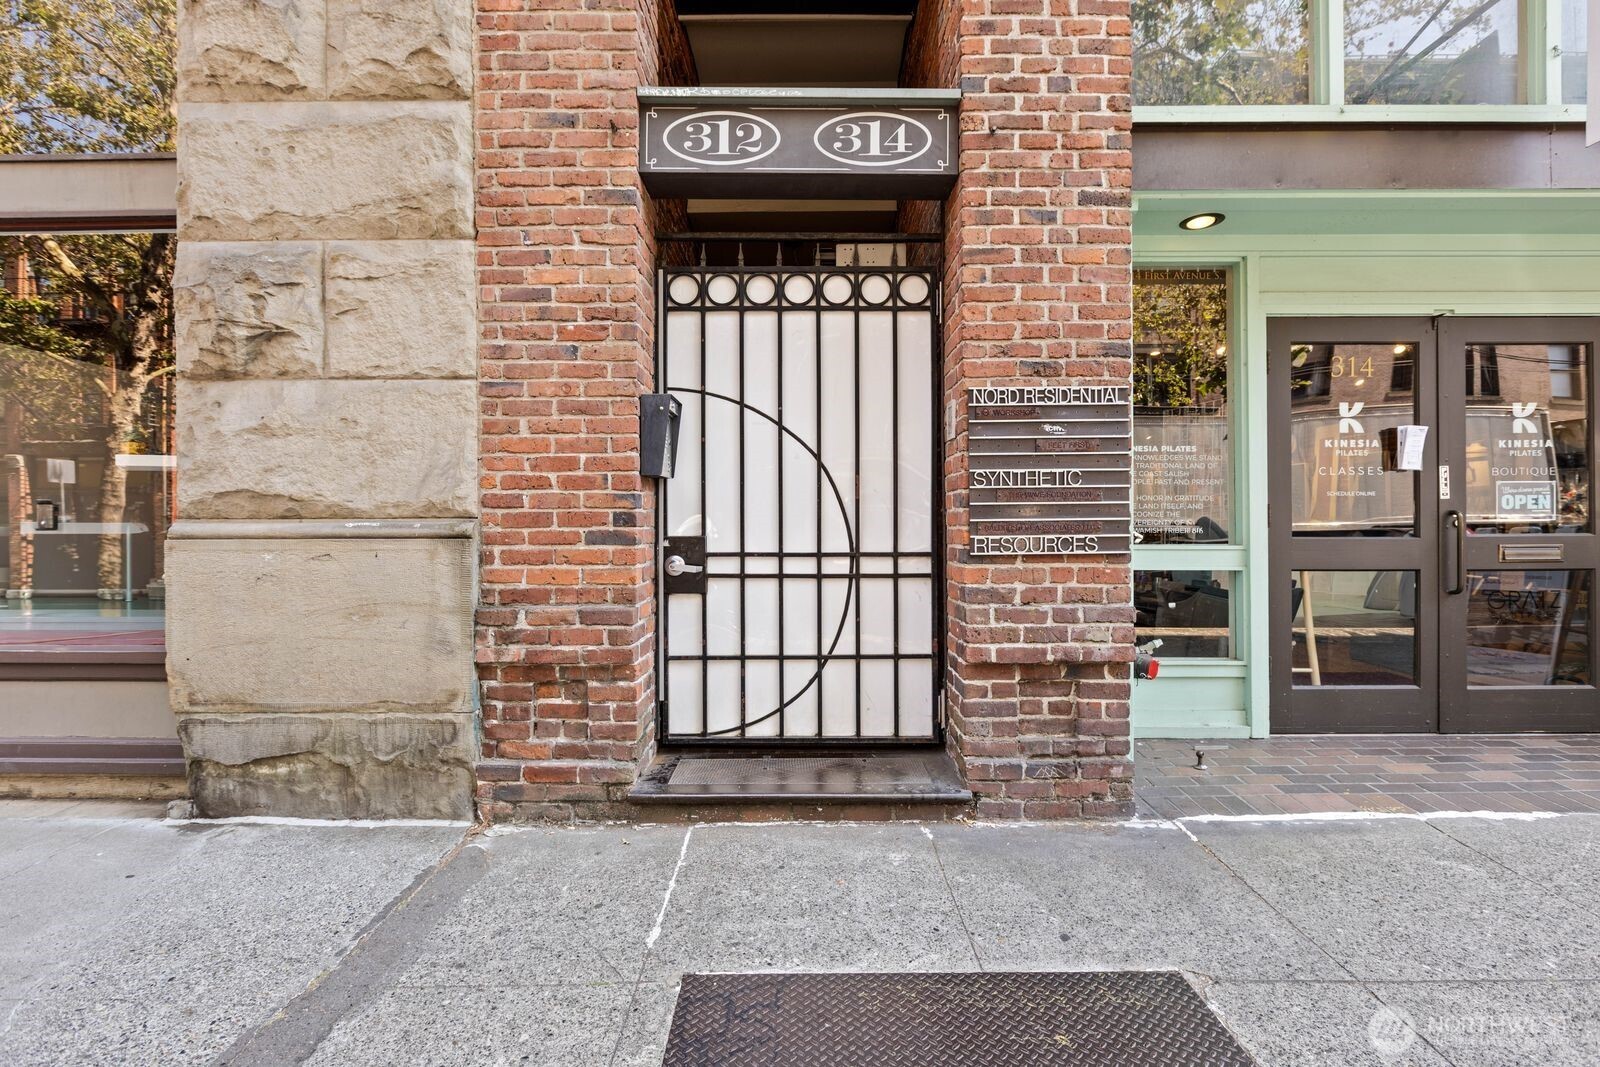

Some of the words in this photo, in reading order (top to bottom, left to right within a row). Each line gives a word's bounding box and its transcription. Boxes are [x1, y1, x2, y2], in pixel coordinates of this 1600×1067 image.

[683, 119, 762, 155] 312
[833, 120, 913, 156] 314
[1145, 271, 1169, 280] FIRST
[1173, 271, 1211, 280] AVENUE
[1331, 356, 1375, 377] 314
[973, 389, 1018, 404] NORD
[1025, 388, 1125, 403] RESIDENTIAL
[1324, 439, 1380, 448] KINESIA
[1498, 439, 1554, 448] KINESIA
[1335, 449, 1369, 457] PILATES
[1509, 449, 1543, 457] PILATES
[1318, 466, 1384, 475] CLASSES
[1491, 467, 1556, 476] BOUTIQUE
[973, 470, 1082, 486] SYNTHETIC
[1174, 494, 1214, 502] GRATITUDE
[1501, 494, 1551, 510] OPEN
[974, 537, 1099, 553] RESOURCES
